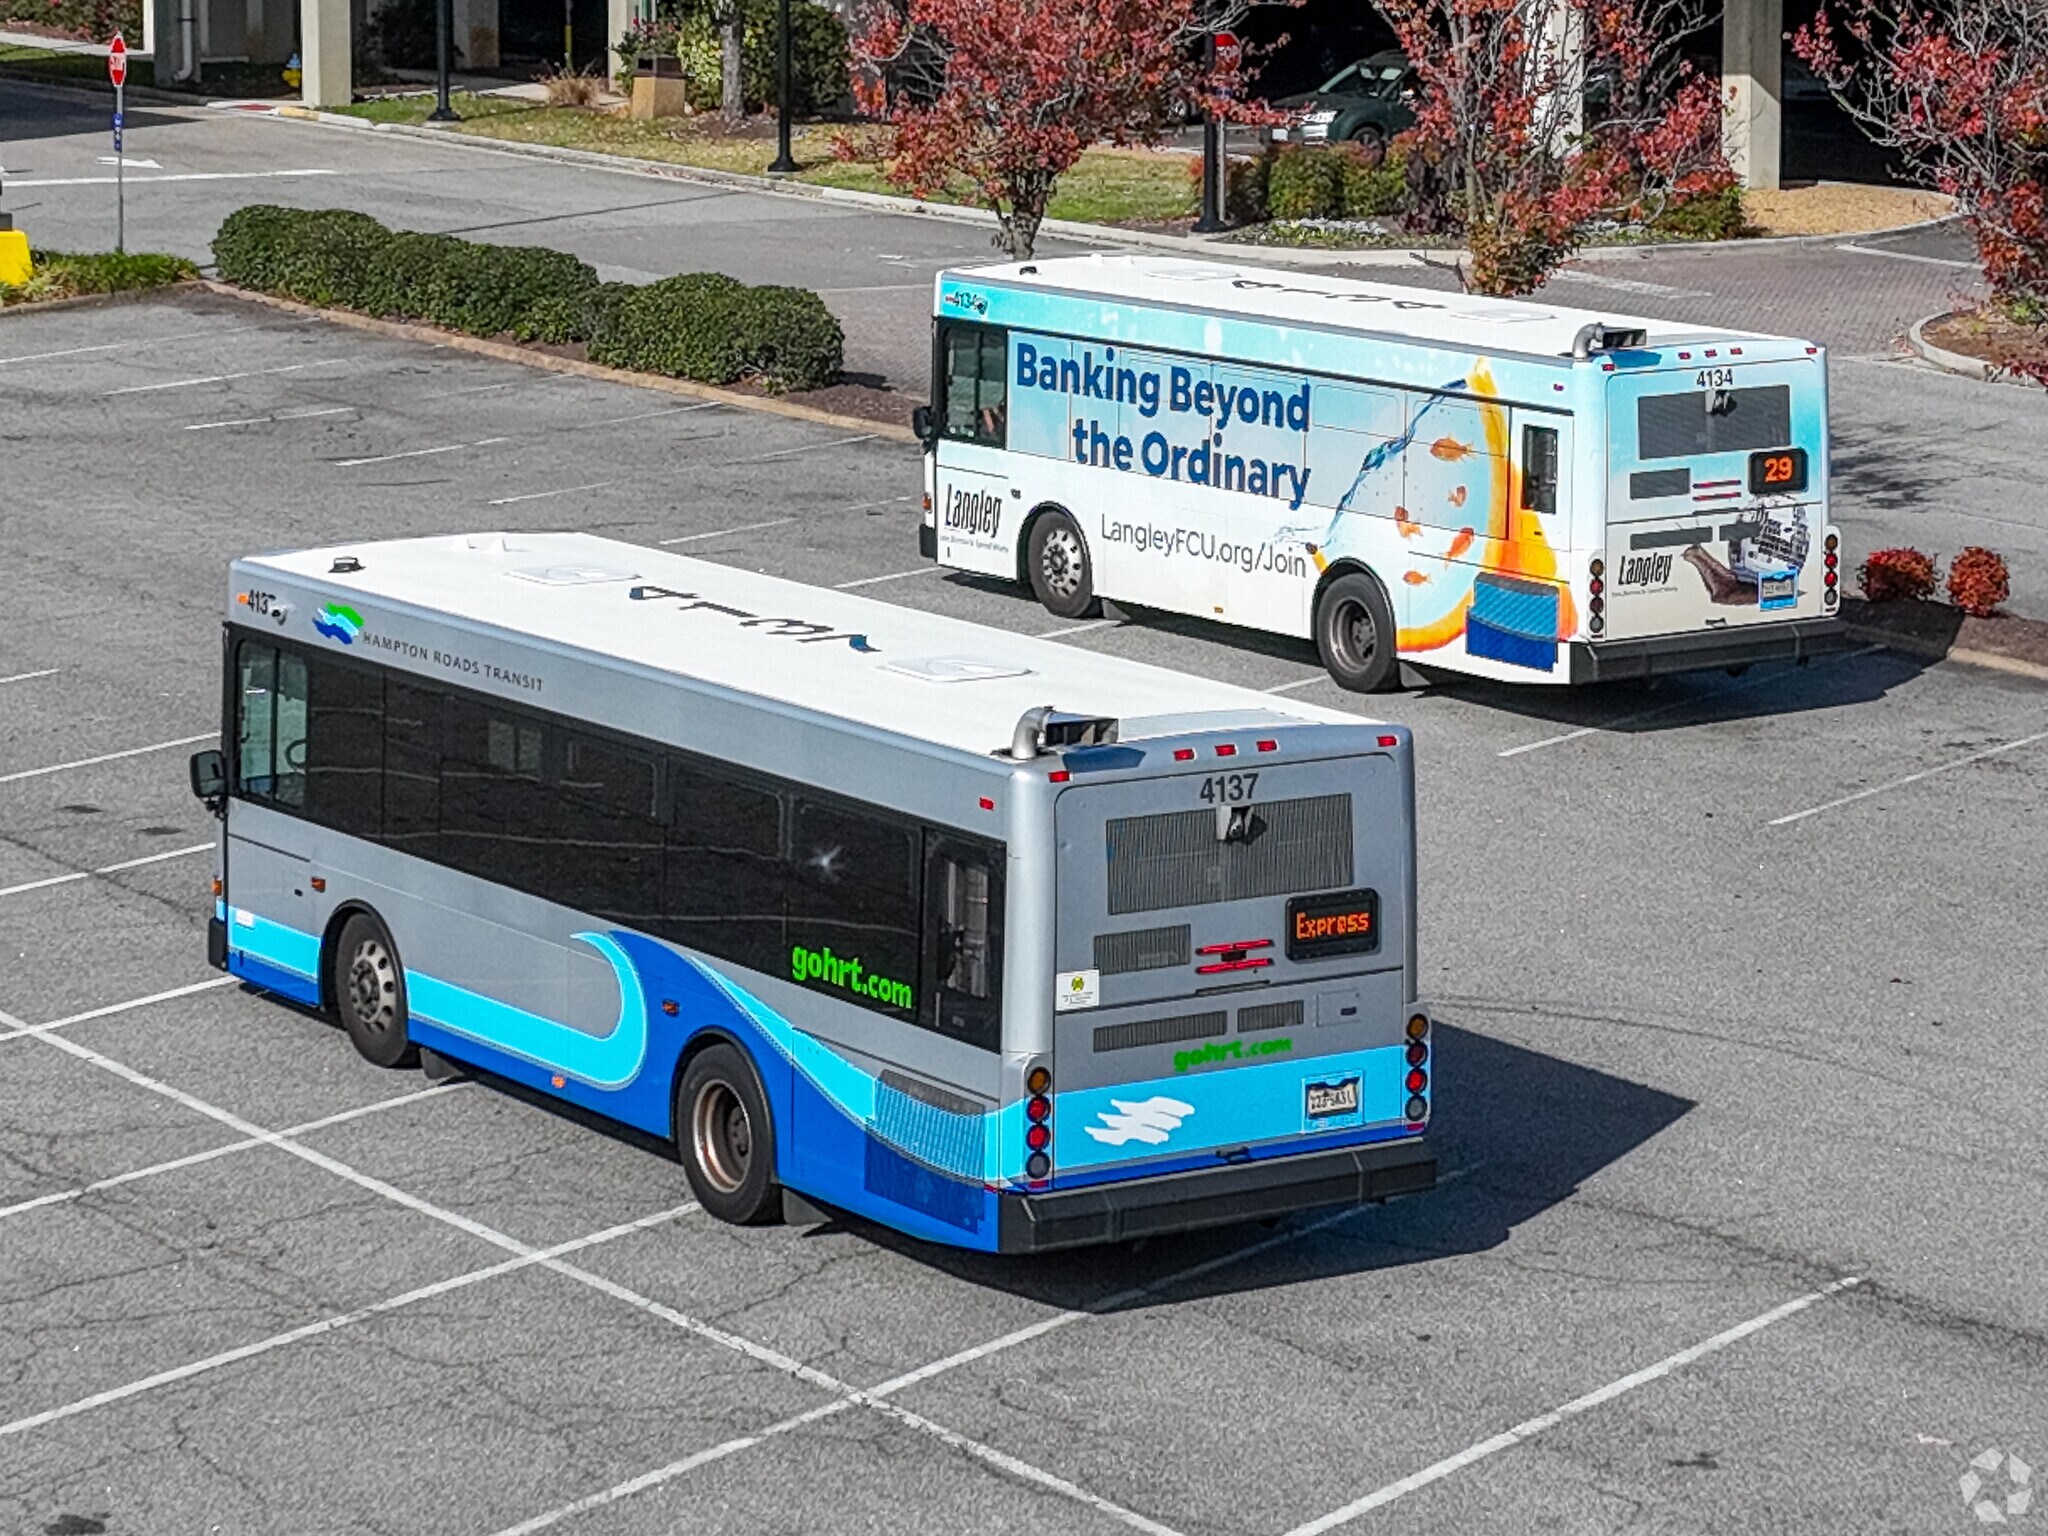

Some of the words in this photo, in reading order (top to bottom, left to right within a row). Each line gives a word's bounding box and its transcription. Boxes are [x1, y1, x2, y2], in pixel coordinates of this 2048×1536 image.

[1016, 342, 1160, 417] Banking
[1170, 366, 1310, 432] Beyond
[1696, 368, 1734, 387] 4134
[1073, 418, 1133, 470] the
[1141, 430, 1311, 511] Ordinary
[1764, 456, 1794, 483] 29
[945, 483, 1002, 538] Langley
[1101, 513, 1307, 578] LangleyFCU.org/Join
[1618, 552, 1673, 587] Langley
[629, 586, 882, 653] 4137
[363, 631, 428, 661] HAMPTON
[433, 650, 480, 675] ROADS
[484, 664, 544, 692] TRANSIT
[1200, 772, 1259, 804] 4137
[1296, 911, 1371, 940] Express
[792, 946, 912, 1009] gohrt.com
[1173, 1037, 1292, 1072] gohrt.com
